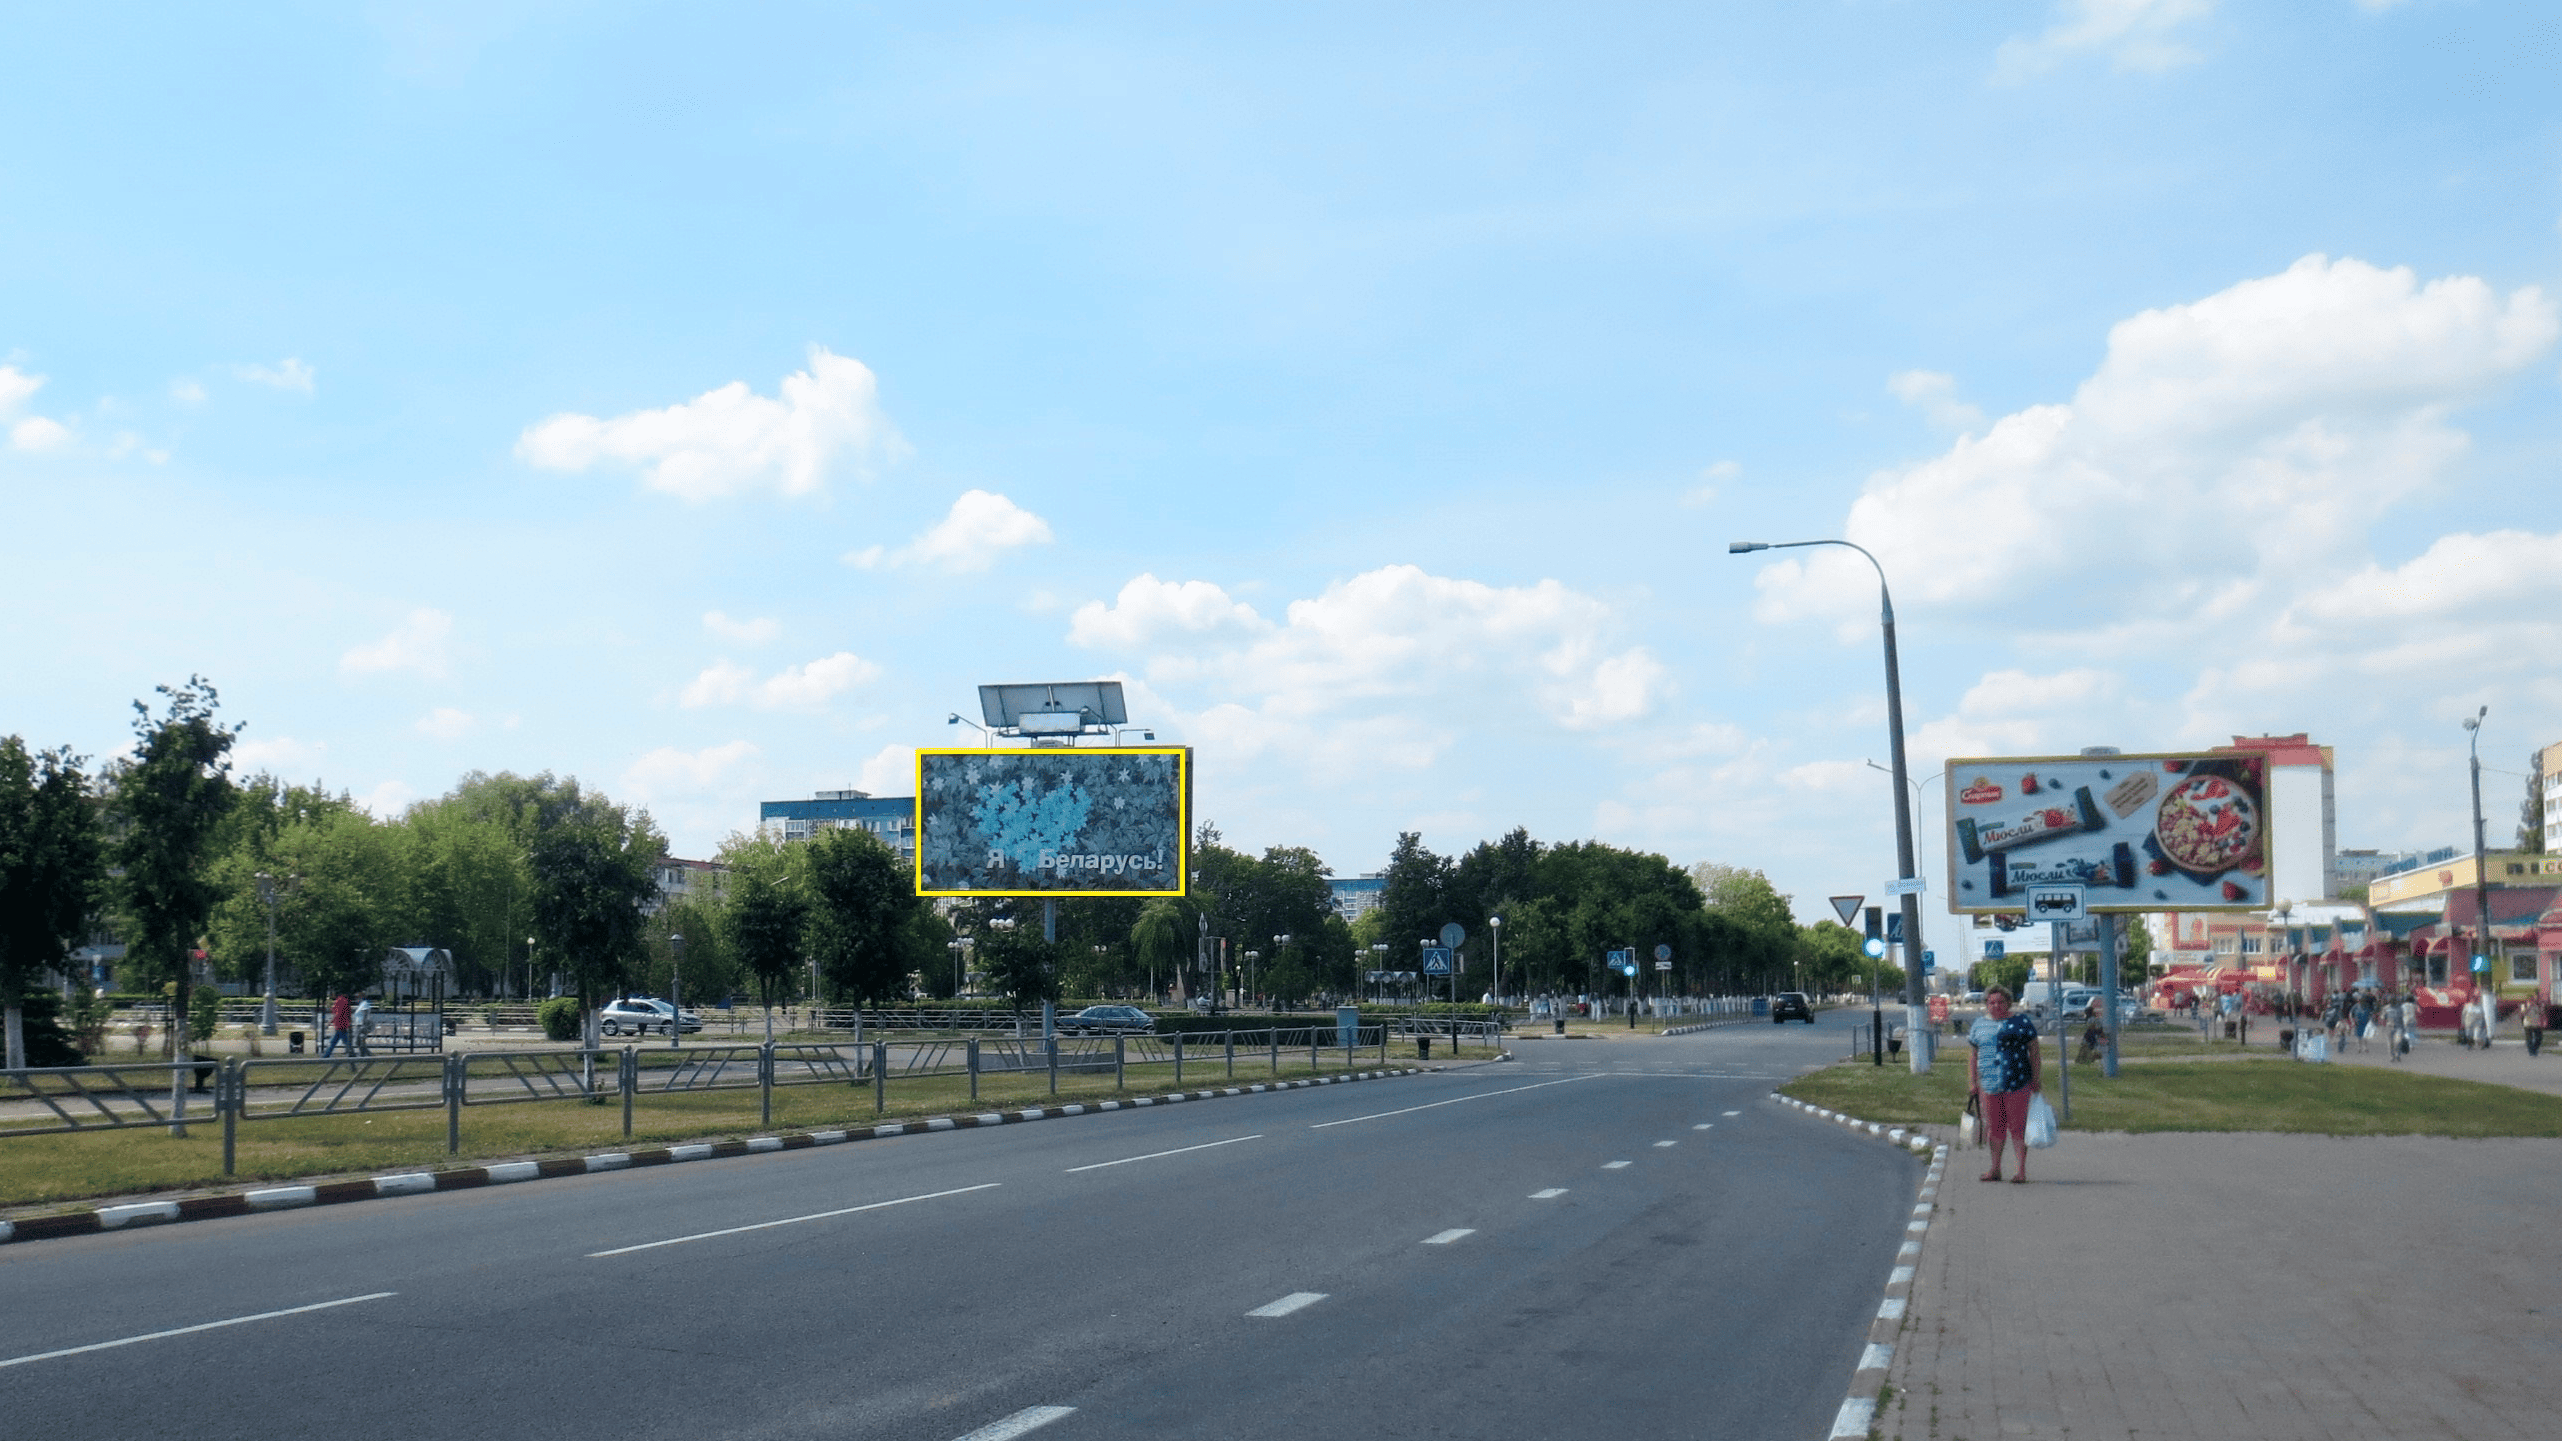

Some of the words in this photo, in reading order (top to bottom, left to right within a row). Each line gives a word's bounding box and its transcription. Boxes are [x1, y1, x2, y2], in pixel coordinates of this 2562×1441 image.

[1983, 824, 2035, 845] Мюсли
[986, 849, 1005, 869] Я
[1038, 848, 1164, 875] Беларусь!
[2011, 869, 2066, 883] Мюсли
